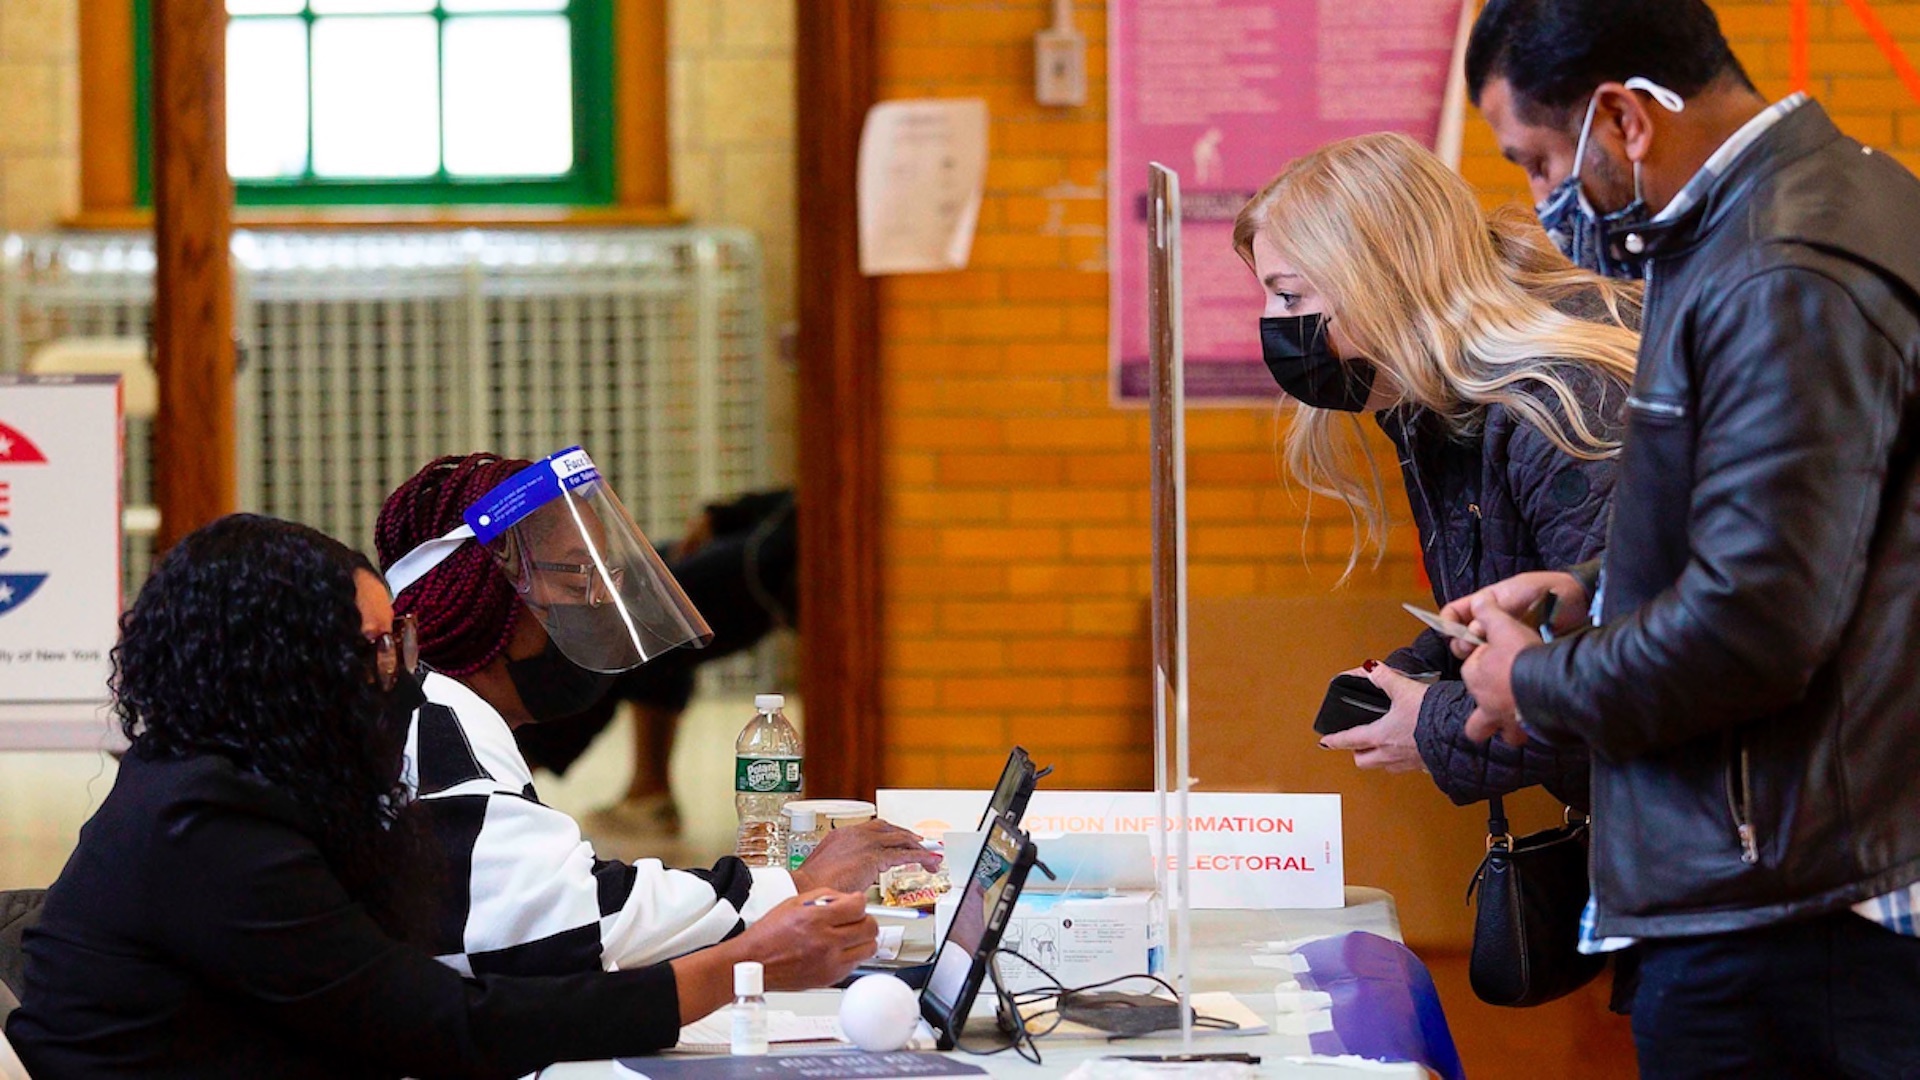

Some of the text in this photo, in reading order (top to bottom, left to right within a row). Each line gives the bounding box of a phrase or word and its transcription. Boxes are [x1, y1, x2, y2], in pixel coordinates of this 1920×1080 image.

[18, 649, 33, 662] of
[36, 649, 66, 661] New
[72, 649, 100, 661] York
[747, 760, 780, 777] Poland
[748, 770, 782, 787] Spring
